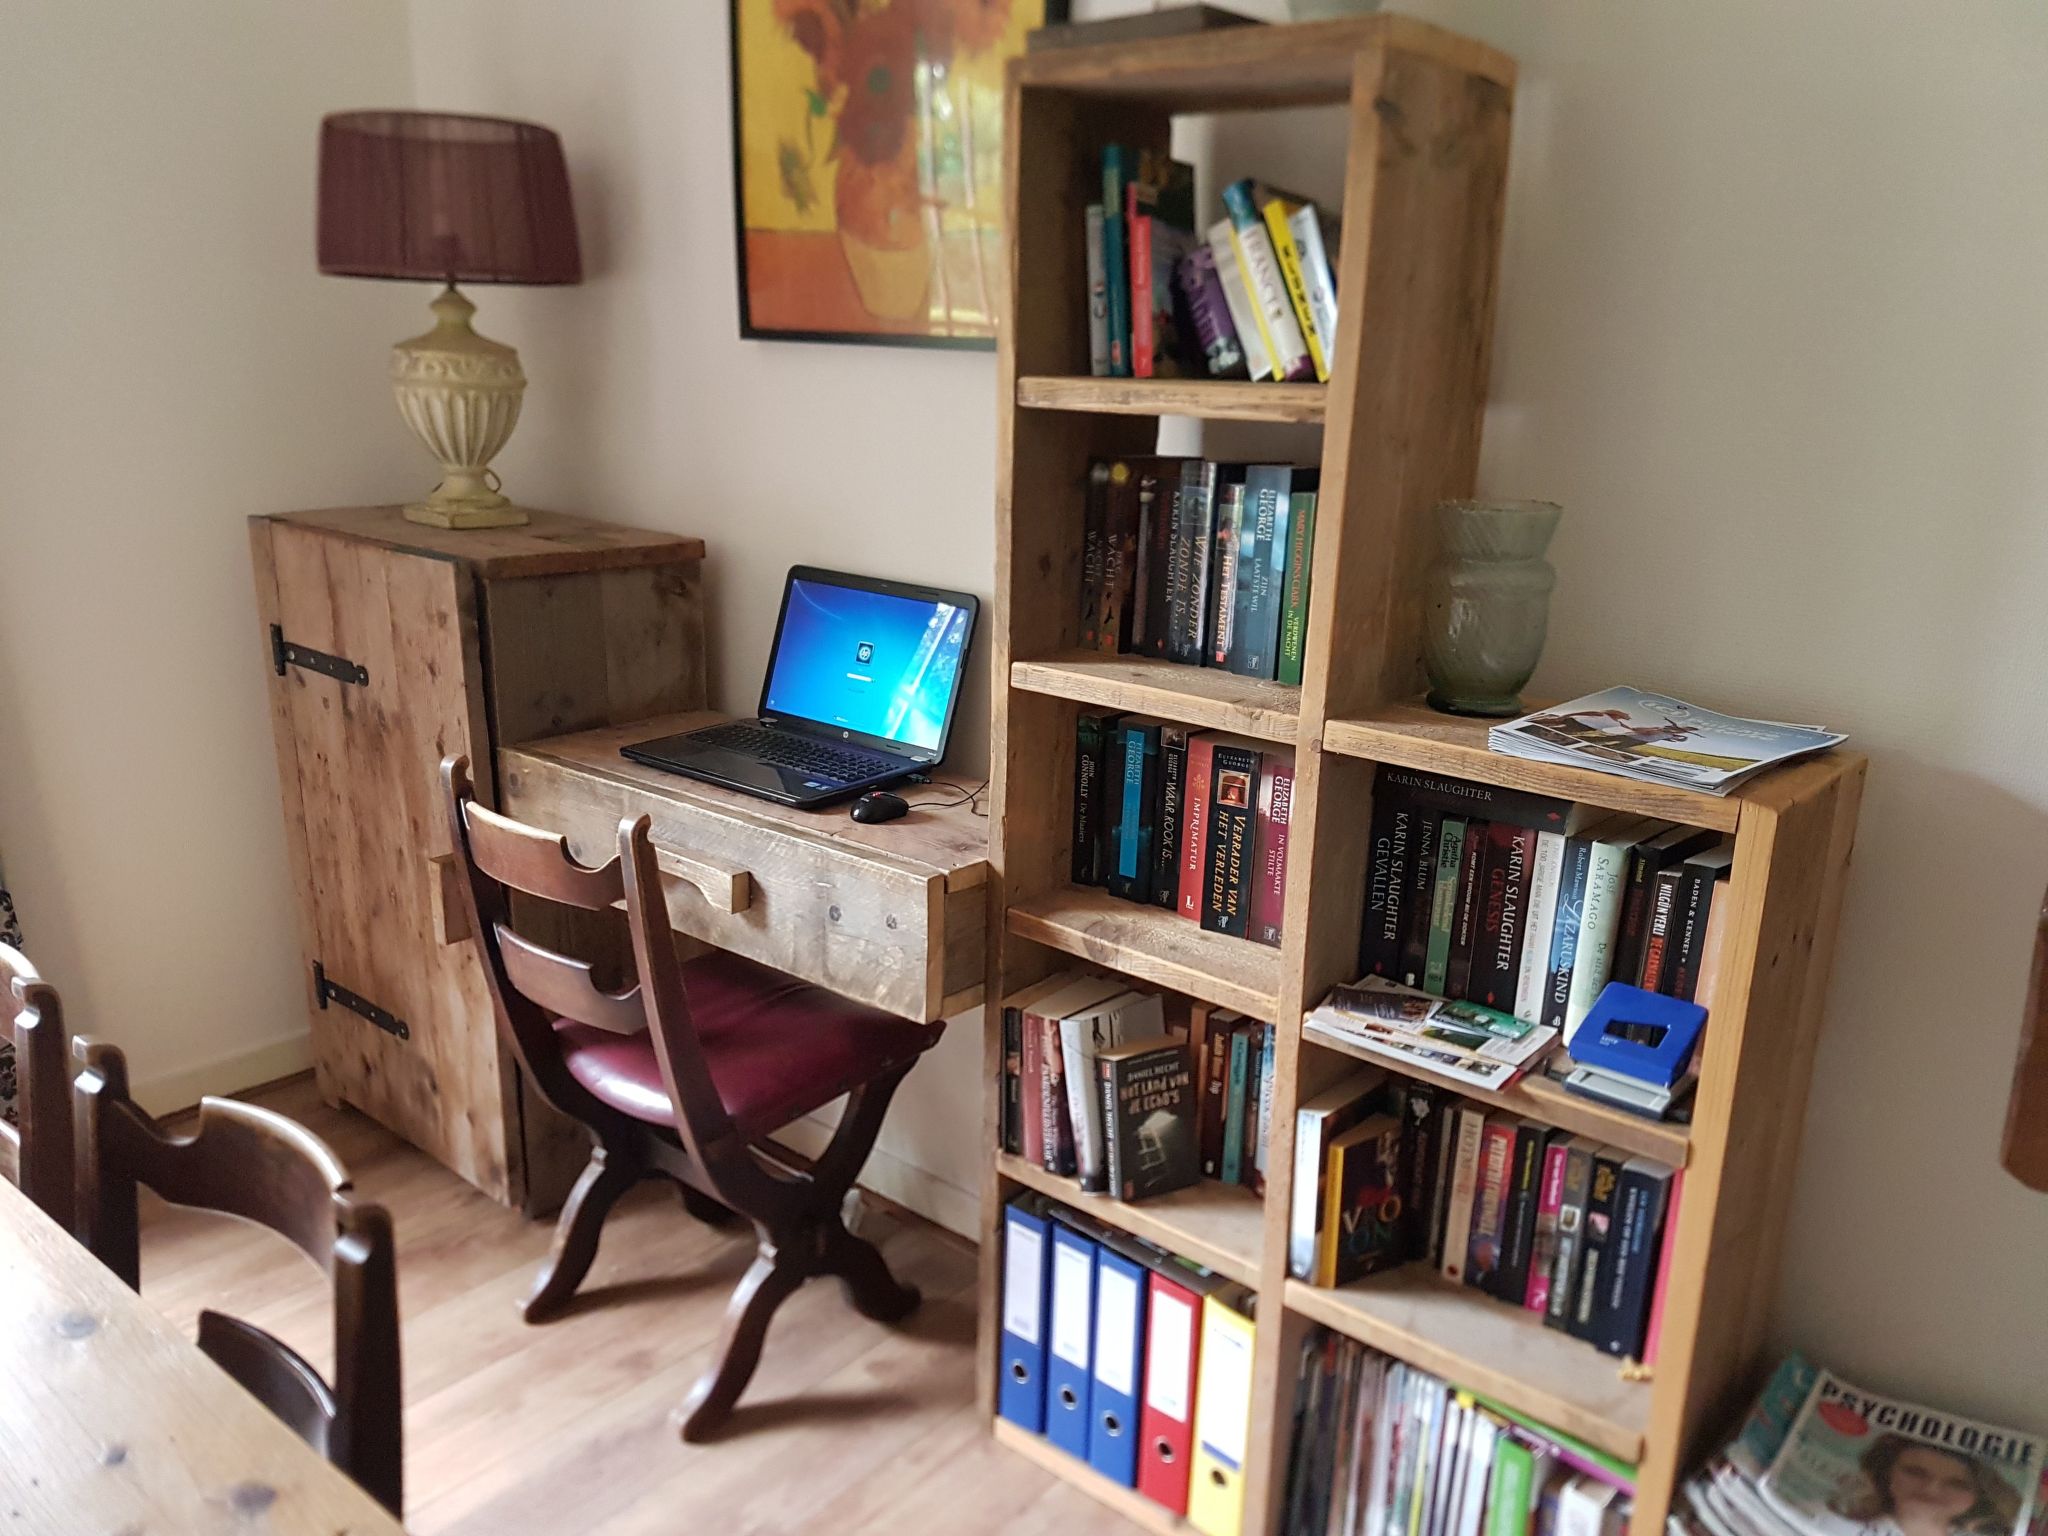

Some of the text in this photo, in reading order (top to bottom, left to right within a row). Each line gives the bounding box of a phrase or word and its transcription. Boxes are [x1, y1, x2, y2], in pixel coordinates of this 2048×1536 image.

[1256, 488, 1268, 541] GEORGE
[1265, 490, 1276, 541] ELIZABETH
[1084, 529, 1096, 584] WACHT
[1105, 534, 1118, 589] WACHT
[1165, 491, 1180, 603] KARIN SLAUGHTER
[1178, 536, 1191, 591] ZONDE
[1188, 535, 1207, 639] WIE ZONDER
[1251, 558, 1261, 595] LAATSTE
[1260, 576, 1268, 596] ZIJN
[1284, 631, 1292, 656] NACHT
[1286, 620, 1293, 629] DE
[1290, 617, 1300, 660] VERDWENEN
[1080, 754, 1090, 799] CONNOLLY
[1127, 740, 1135, 784] GEORGE
[1134, 742, 1143, 785] ELIZABETH
[1218, 752, 1254, 765] ELIZABETH
[1223, 759, 1250, 768] GEORGE
[1165, 782, 1177, 813] WAAR
[1272, 776, 1284, 823] GEORGE
[1280, 778, 1290, 824] ELIZABETH
[1387, 771, 1492, 801] KARIN SLAUGHTER
[1163, 816, 1174, 846] ROOK
[1189, 798, 1201, 871] IMPRIMATUR
[1440, 832, 1453, 868] Christie
[1450, 836, 1461, 868] Agatha
[1212, 810, 1228, 913] HET VERLEDEN
[1227, 815, 1246, 916] VERRADER VAN
[1267, 849, 1275, 876] STILTE
[1273, 834, 1285, 895] IN VOLMAAKTE
[1371, 837, 1391, 911] GEVALLEN
[1384, 812, 1409, 940] KARIN SLAUGHTER
[1416, 820, 1433, 890] JENNA BLUM
[1576, 847, 1587, 871] Robert
[1486, 868, 1505, 932] GENESIS
[1496, 836, 1525, 970] KARIN SLAUGHTER
[1587, 857, 1609, 930] SARAMAGO
[1656, 883, 1672, 913] NILGÜN
[1688, 909, 1695, 917] &
[1690, 878, 1701, 908] BADEN
[1653, 914, 1668, 936] YERLI
[1681, 919, 1693, 955] KENNEY
[1820, 1379, 2034, 1466] PSYCHOLOGIE
